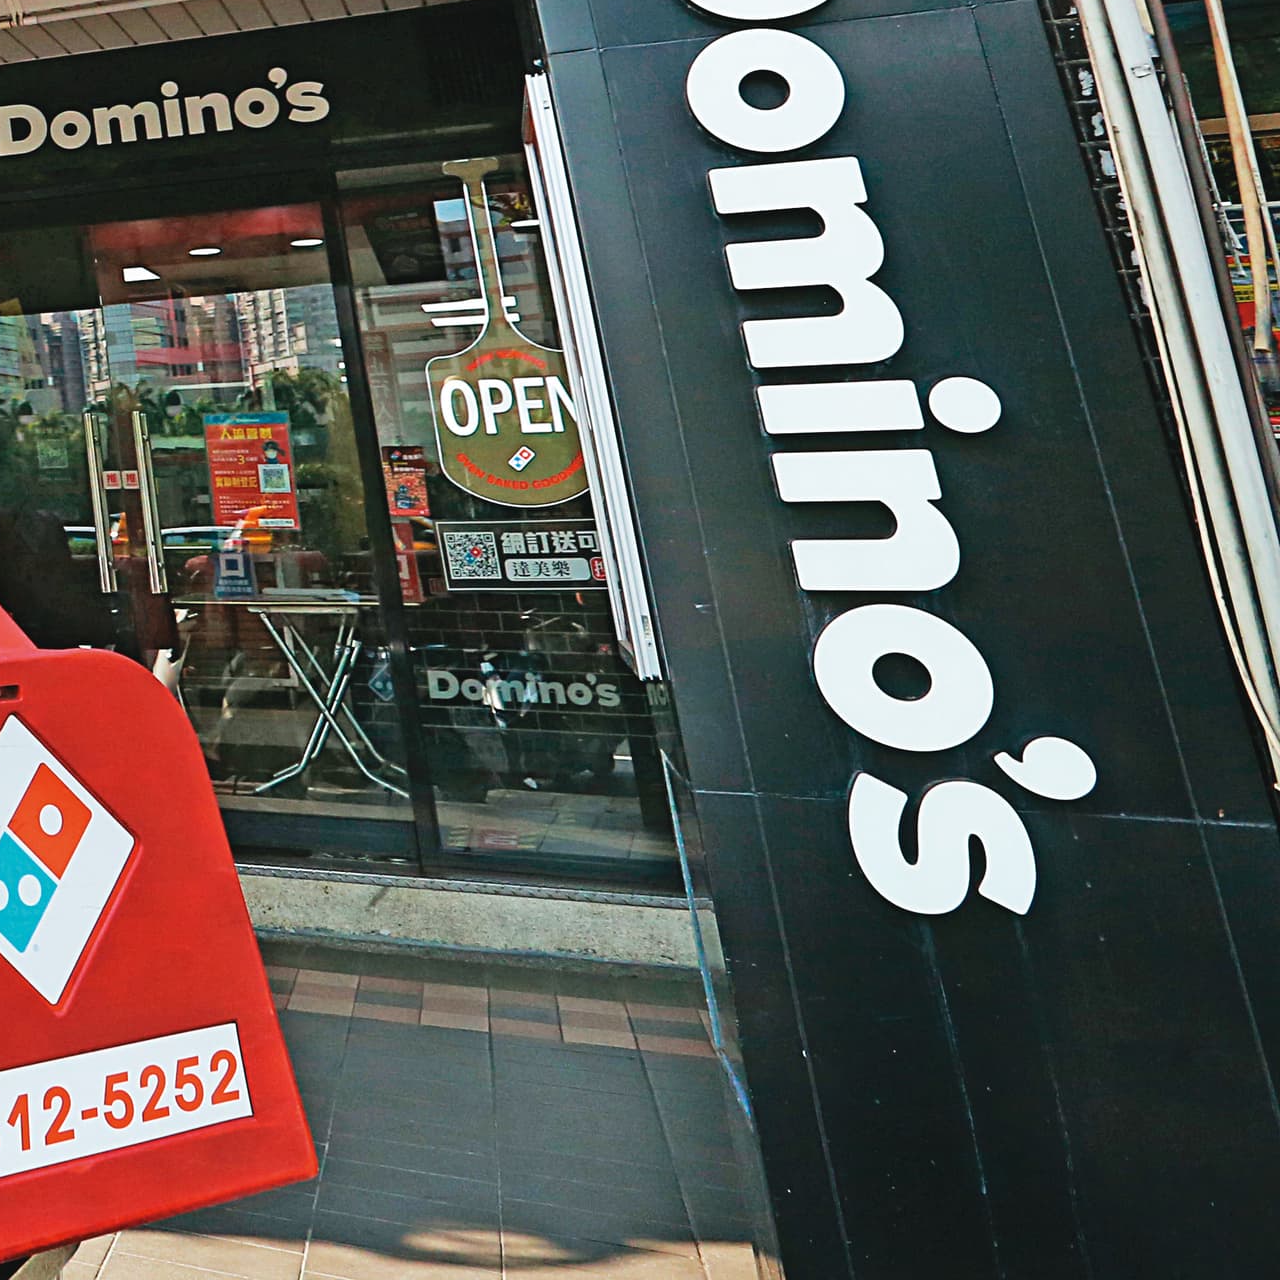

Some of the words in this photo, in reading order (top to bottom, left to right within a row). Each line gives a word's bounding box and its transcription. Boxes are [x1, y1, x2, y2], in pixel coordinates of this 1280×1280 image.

[439, 375, 578, 437] OPEN
[511, 560, 572, 578] 達美樂
[426, 669, 621, 708] Domino's
